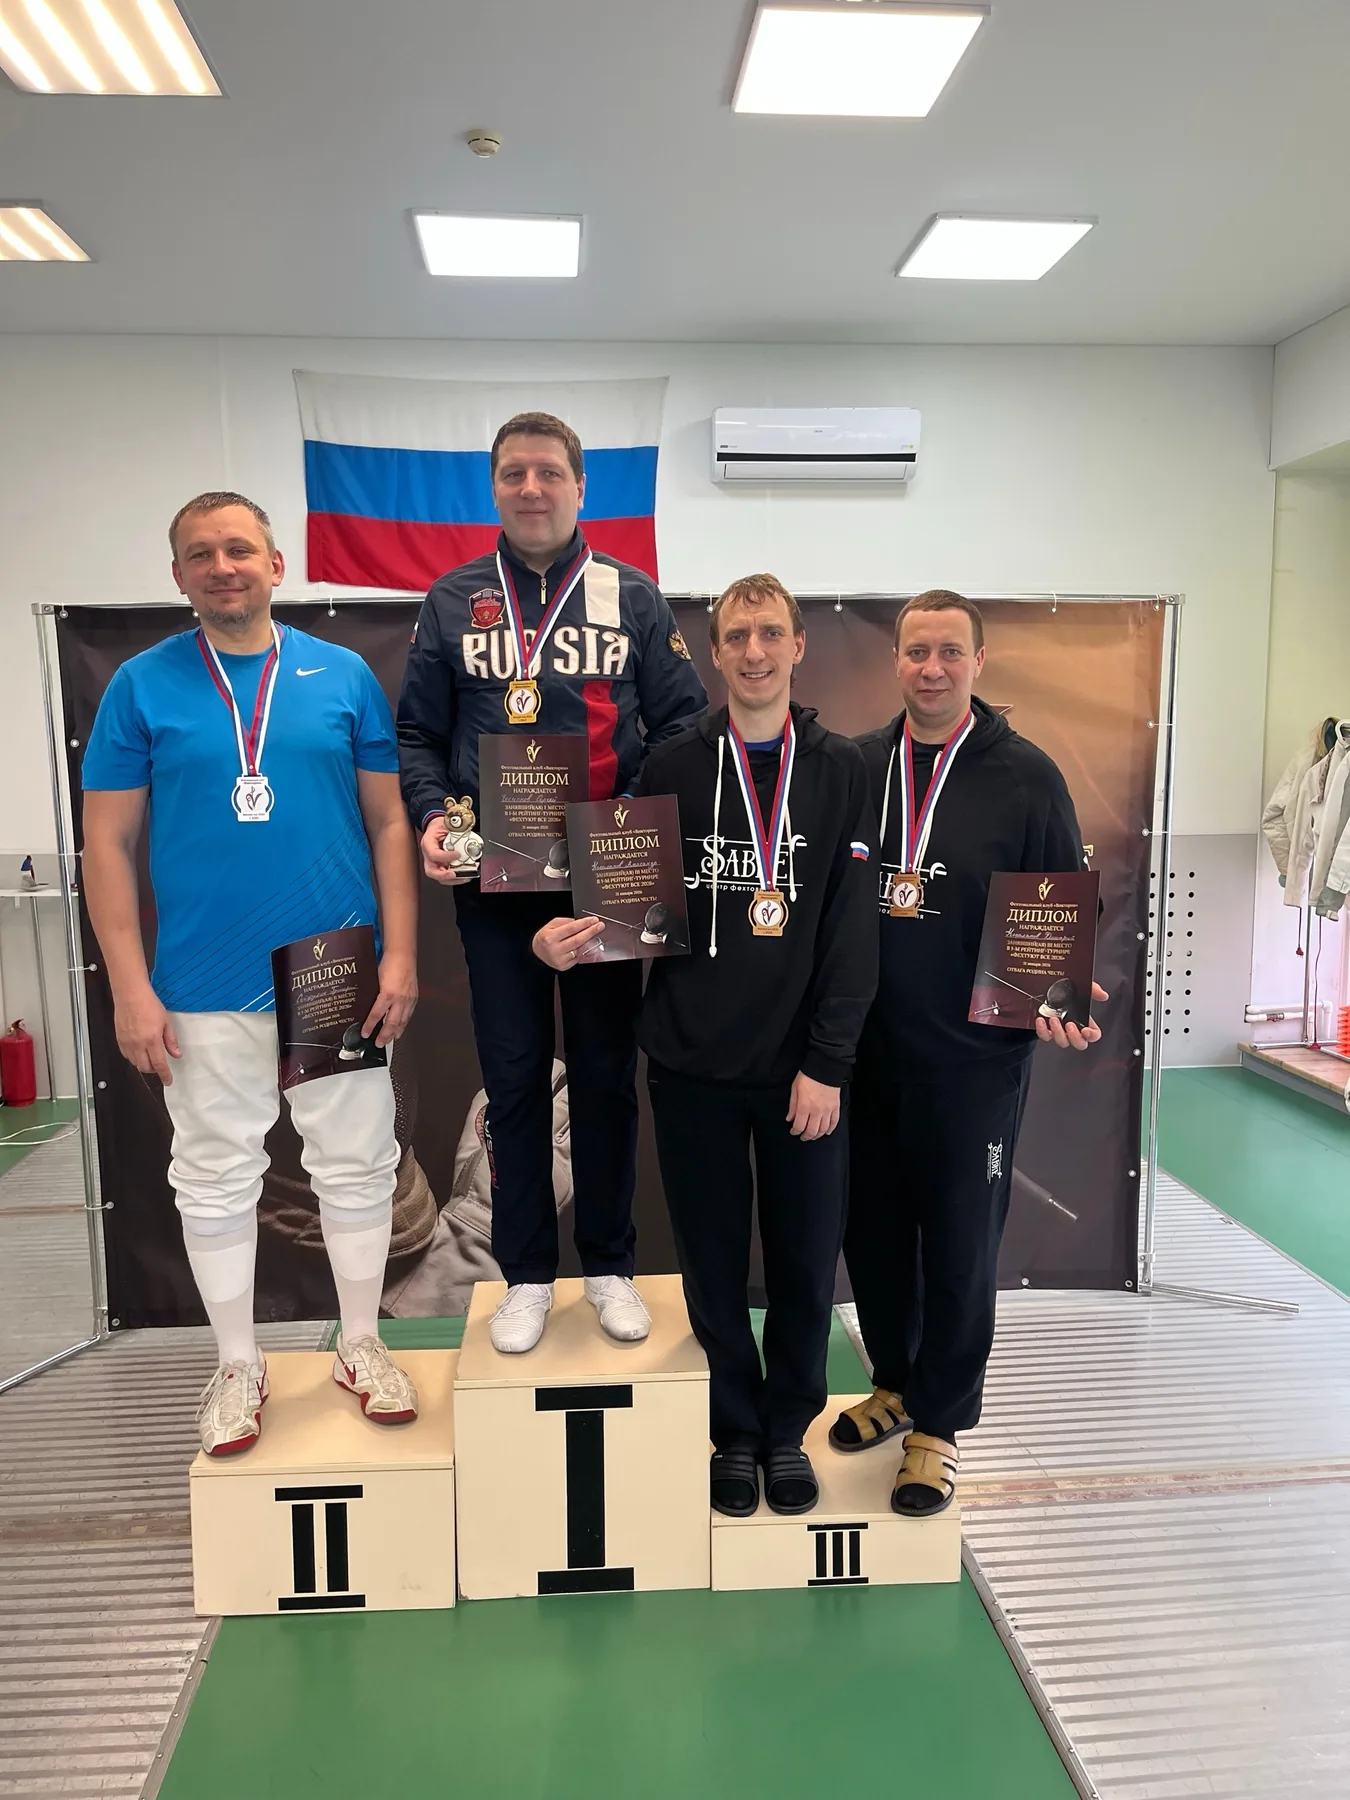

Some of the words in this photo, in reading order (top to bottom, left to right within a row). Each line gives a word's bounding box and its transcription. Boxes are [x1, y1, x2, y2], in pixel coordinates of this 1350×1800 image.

[500, 773, 569, 787] ДИПЛОМ
[590, 836, 660, 854] ДИПЛОМ
[604, 852, 648, 860] НАГРАЖДАЕТСЯ
[701, 834, 788, 880] SABE
[1006, 908, 1078, 923] ДИПЛОМ
[292, 962, 357, 992] ДИПЛОМ
[304, 978, 345, 993] НАГРАЖДАЕТСЯ
[274, 1484, 366, 1611] II
[807, 1522, 869, 1586] III
